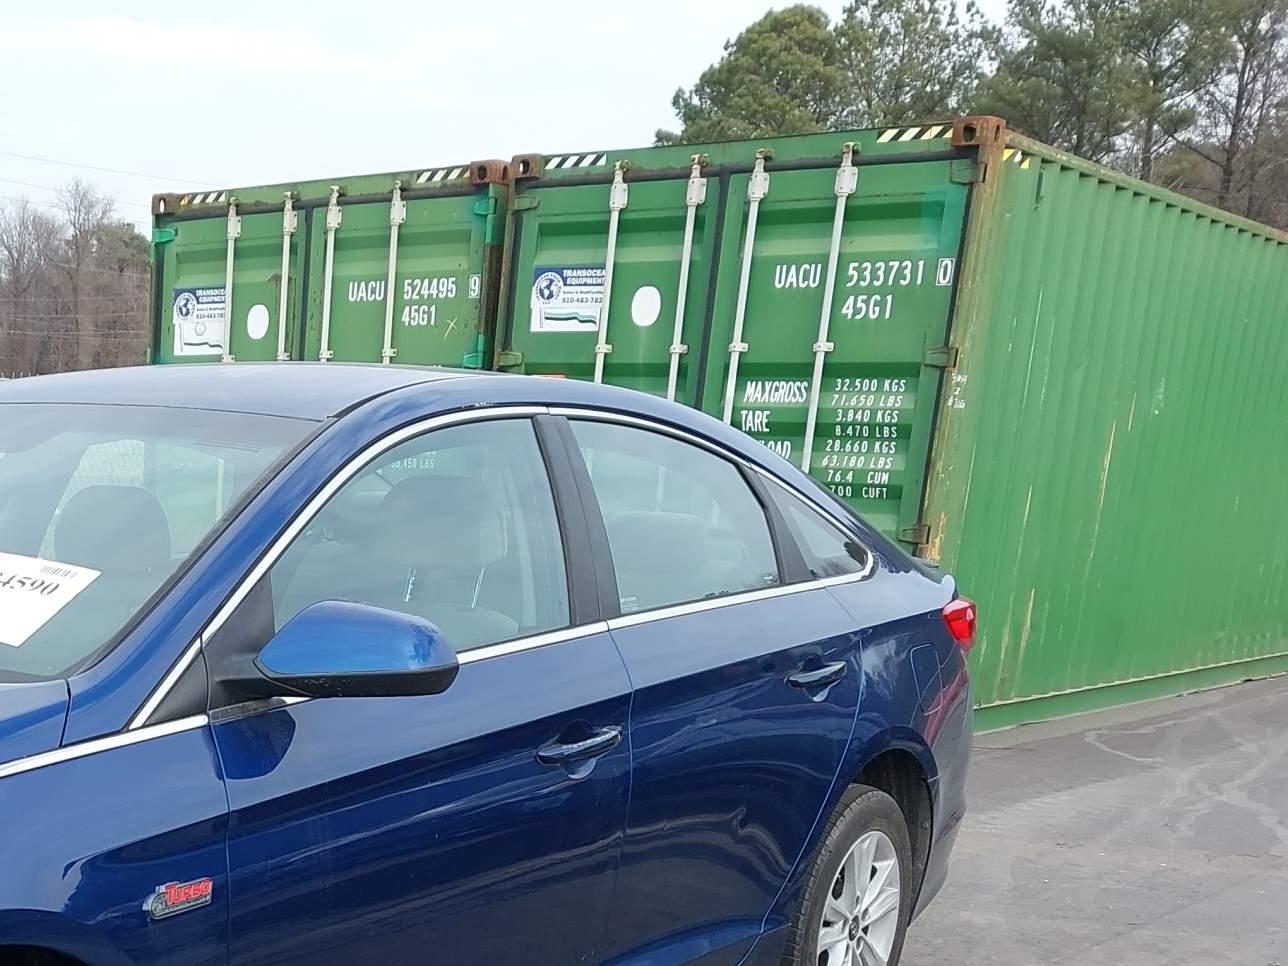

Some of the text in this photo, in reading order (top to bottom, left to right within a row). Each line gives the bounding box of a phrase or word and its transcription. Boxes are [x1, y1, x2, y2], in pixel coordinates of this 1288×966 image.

[774, 263, 822, 289] UACU
[846, 260, 924, 287] 533731
[348, 276, 481, 302] UACU 524495 9
[401, 304, 436, 326] 45G1
[841, 294, 893, 320] 45G1
[743, 378, 906, 403] MAXGROSS 32.500 KGS
[831, 394, 903, 407] 71.650 LBS
[740, 410, 772, 433] TARE
[876, 410, 899, 423] KGS
[875, 425, 897, 438] LBS
[825, 439, 868, 453] 28.660
[873, 441, 896, 454] KGS
[821, 455, 893, 469] 63.180 LBS
[827, 470, 890, 484] 76.4 CUM
[862, 487, 887, 499] CUFT
[166, 880, 211, 906] TURBO
